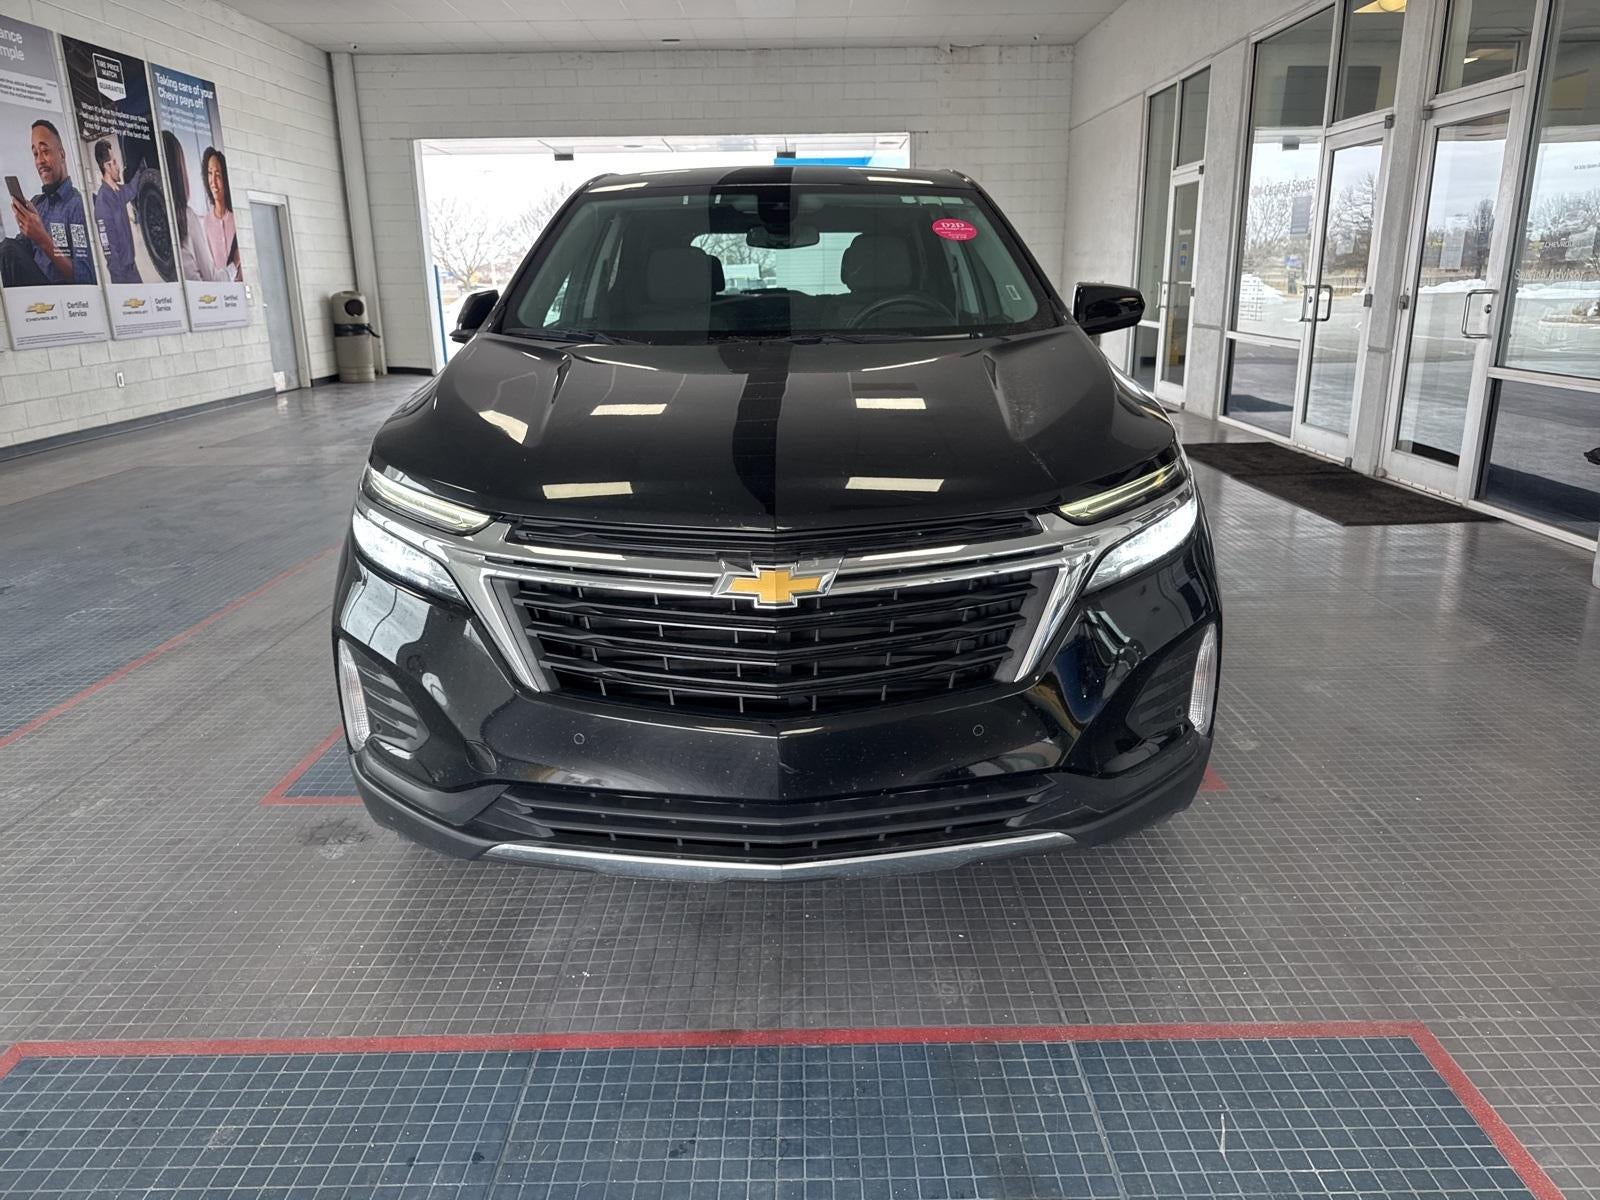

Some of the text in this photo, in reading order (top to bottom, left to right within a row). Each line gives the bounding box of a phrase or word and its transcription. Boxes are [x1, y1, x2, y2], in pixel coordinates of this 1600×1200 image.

[96, 59, 120, 73] TIRE PRICE
[101, 68, 118, 79] MATCH
[99, 82, 125, 94] GUARANTEE
[155, 72, 214, 99] Taking care of your
[158, 87, 205, 109] Chevy pays off
[1291, 177, 1317, 193] Service
[1548, 267, 1586, 281] Advisor
[67, 301, 89, 309] Certified
[155, 297, 173, 305] Certified
[26, 315, 58, 323] CHEVROLET
[69, 310, 88, 318] Service
